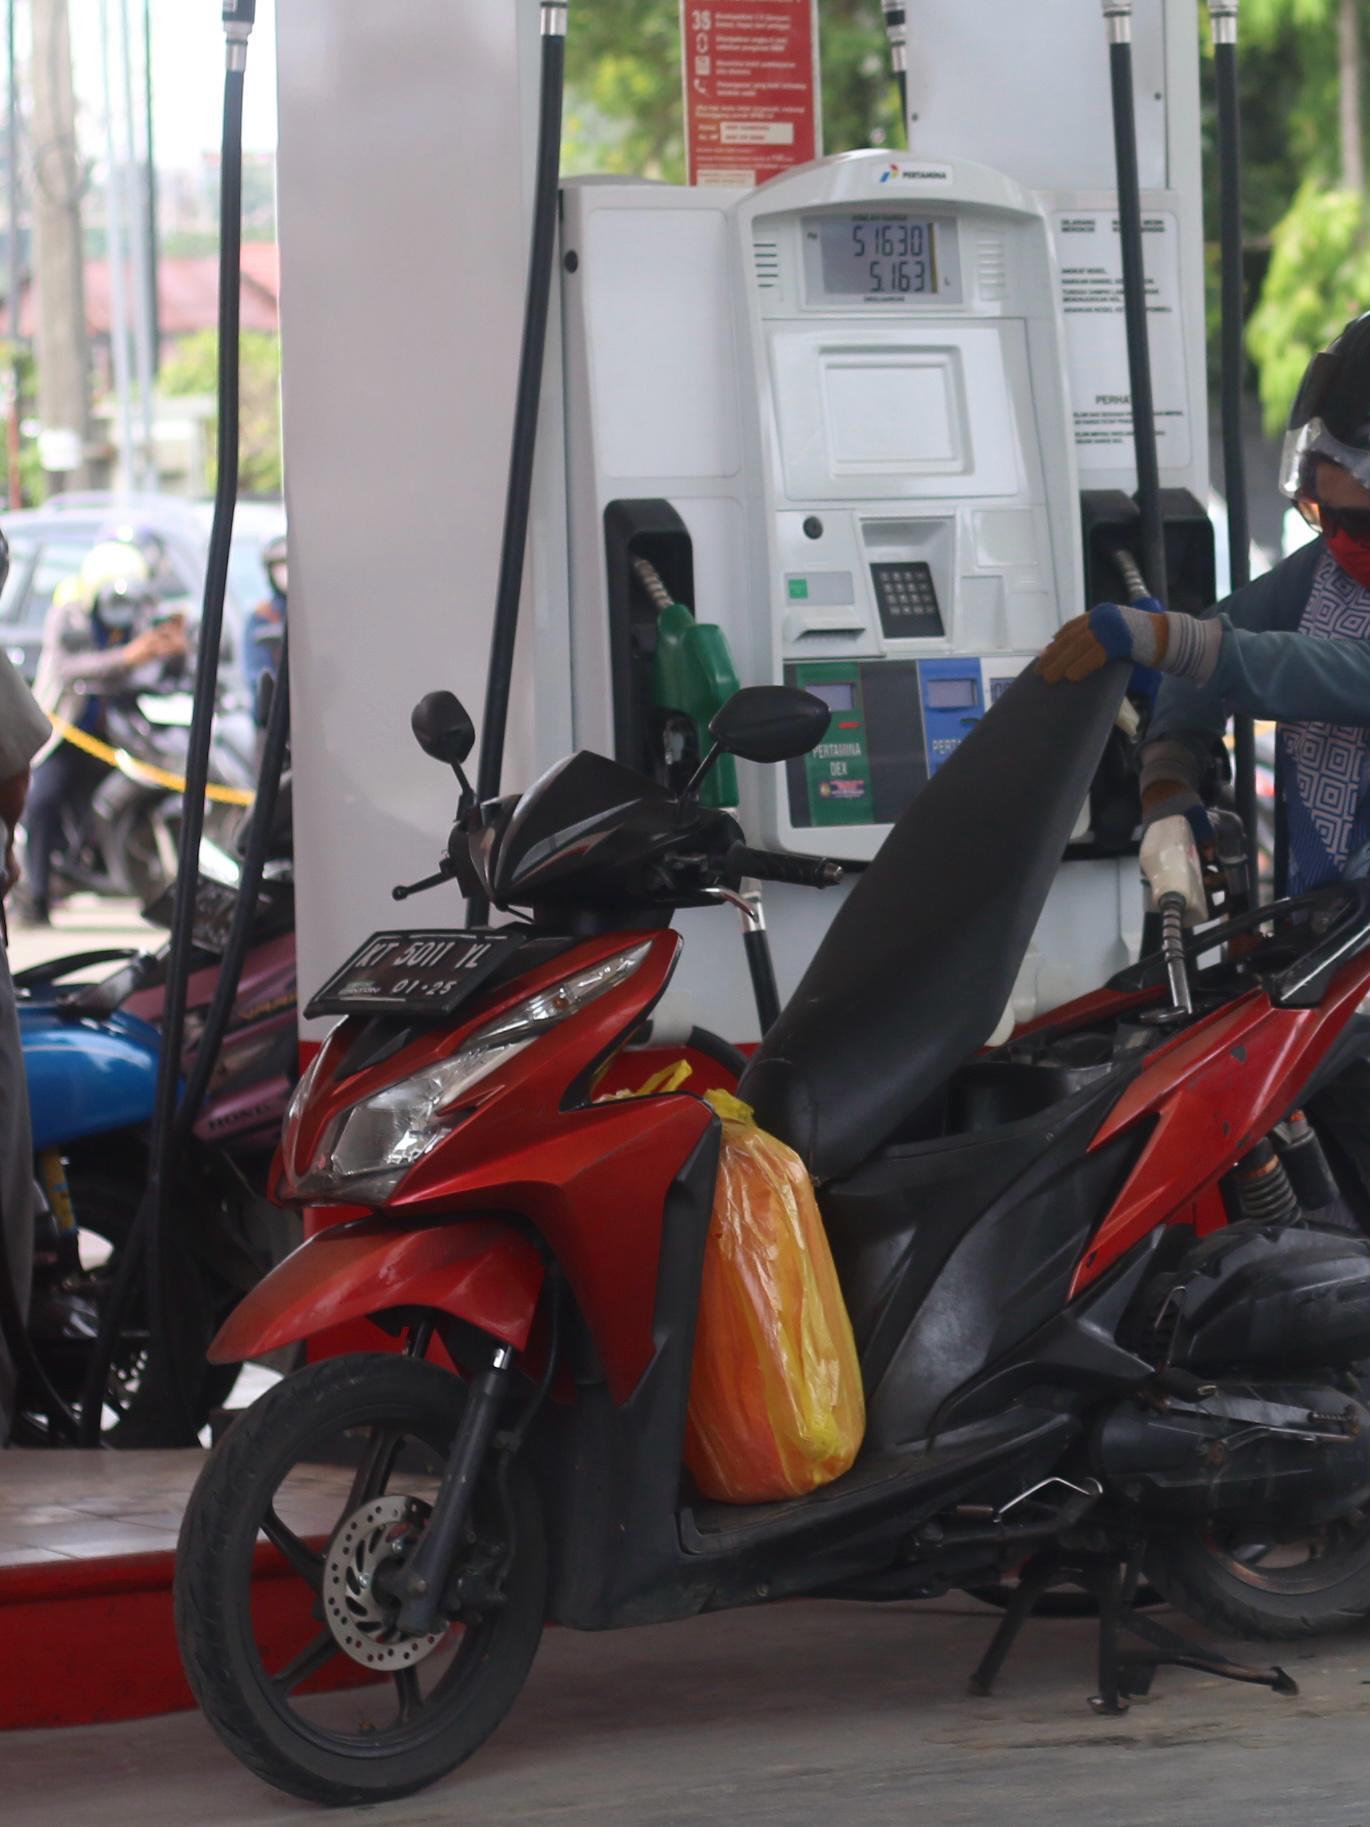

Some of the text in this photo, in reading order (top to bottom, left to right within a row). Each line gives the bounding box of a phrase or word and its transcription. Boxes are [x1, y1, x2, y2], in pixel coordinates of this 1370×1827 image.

[852, 225, 923, 257] 51630
[830, 761, 848, 776] DEX
[355, 941, 492, 969] KT 5011 YL
